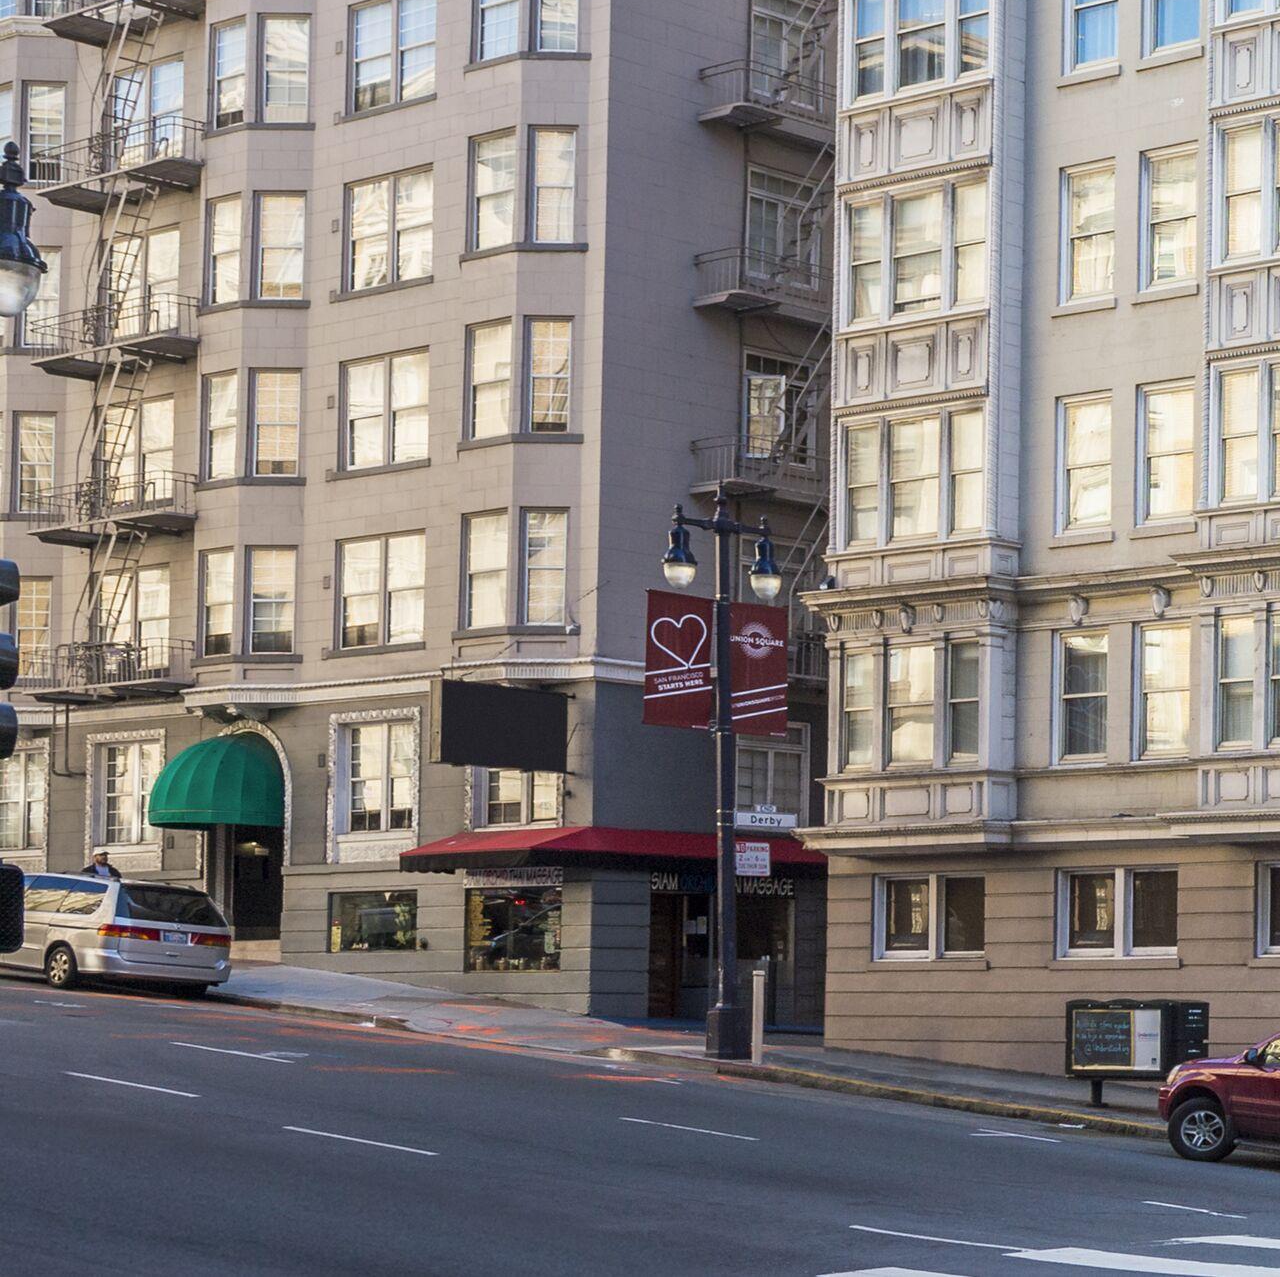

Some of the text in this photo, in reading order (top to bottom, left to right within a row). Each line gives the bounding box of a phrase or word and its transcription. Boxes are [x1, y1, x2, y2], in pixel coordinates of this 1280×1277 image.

[730, 635, 784, 647] UNION SQUARE
[654, 671, 704, 684] SAN FRANCISCO
[658, 678, 704, 691] STARTS HERE
[750, 815, 783, 826] Derby
[651, 872, 678, 891] SIAM
[743, 878, 794, 896] MASSAGE
